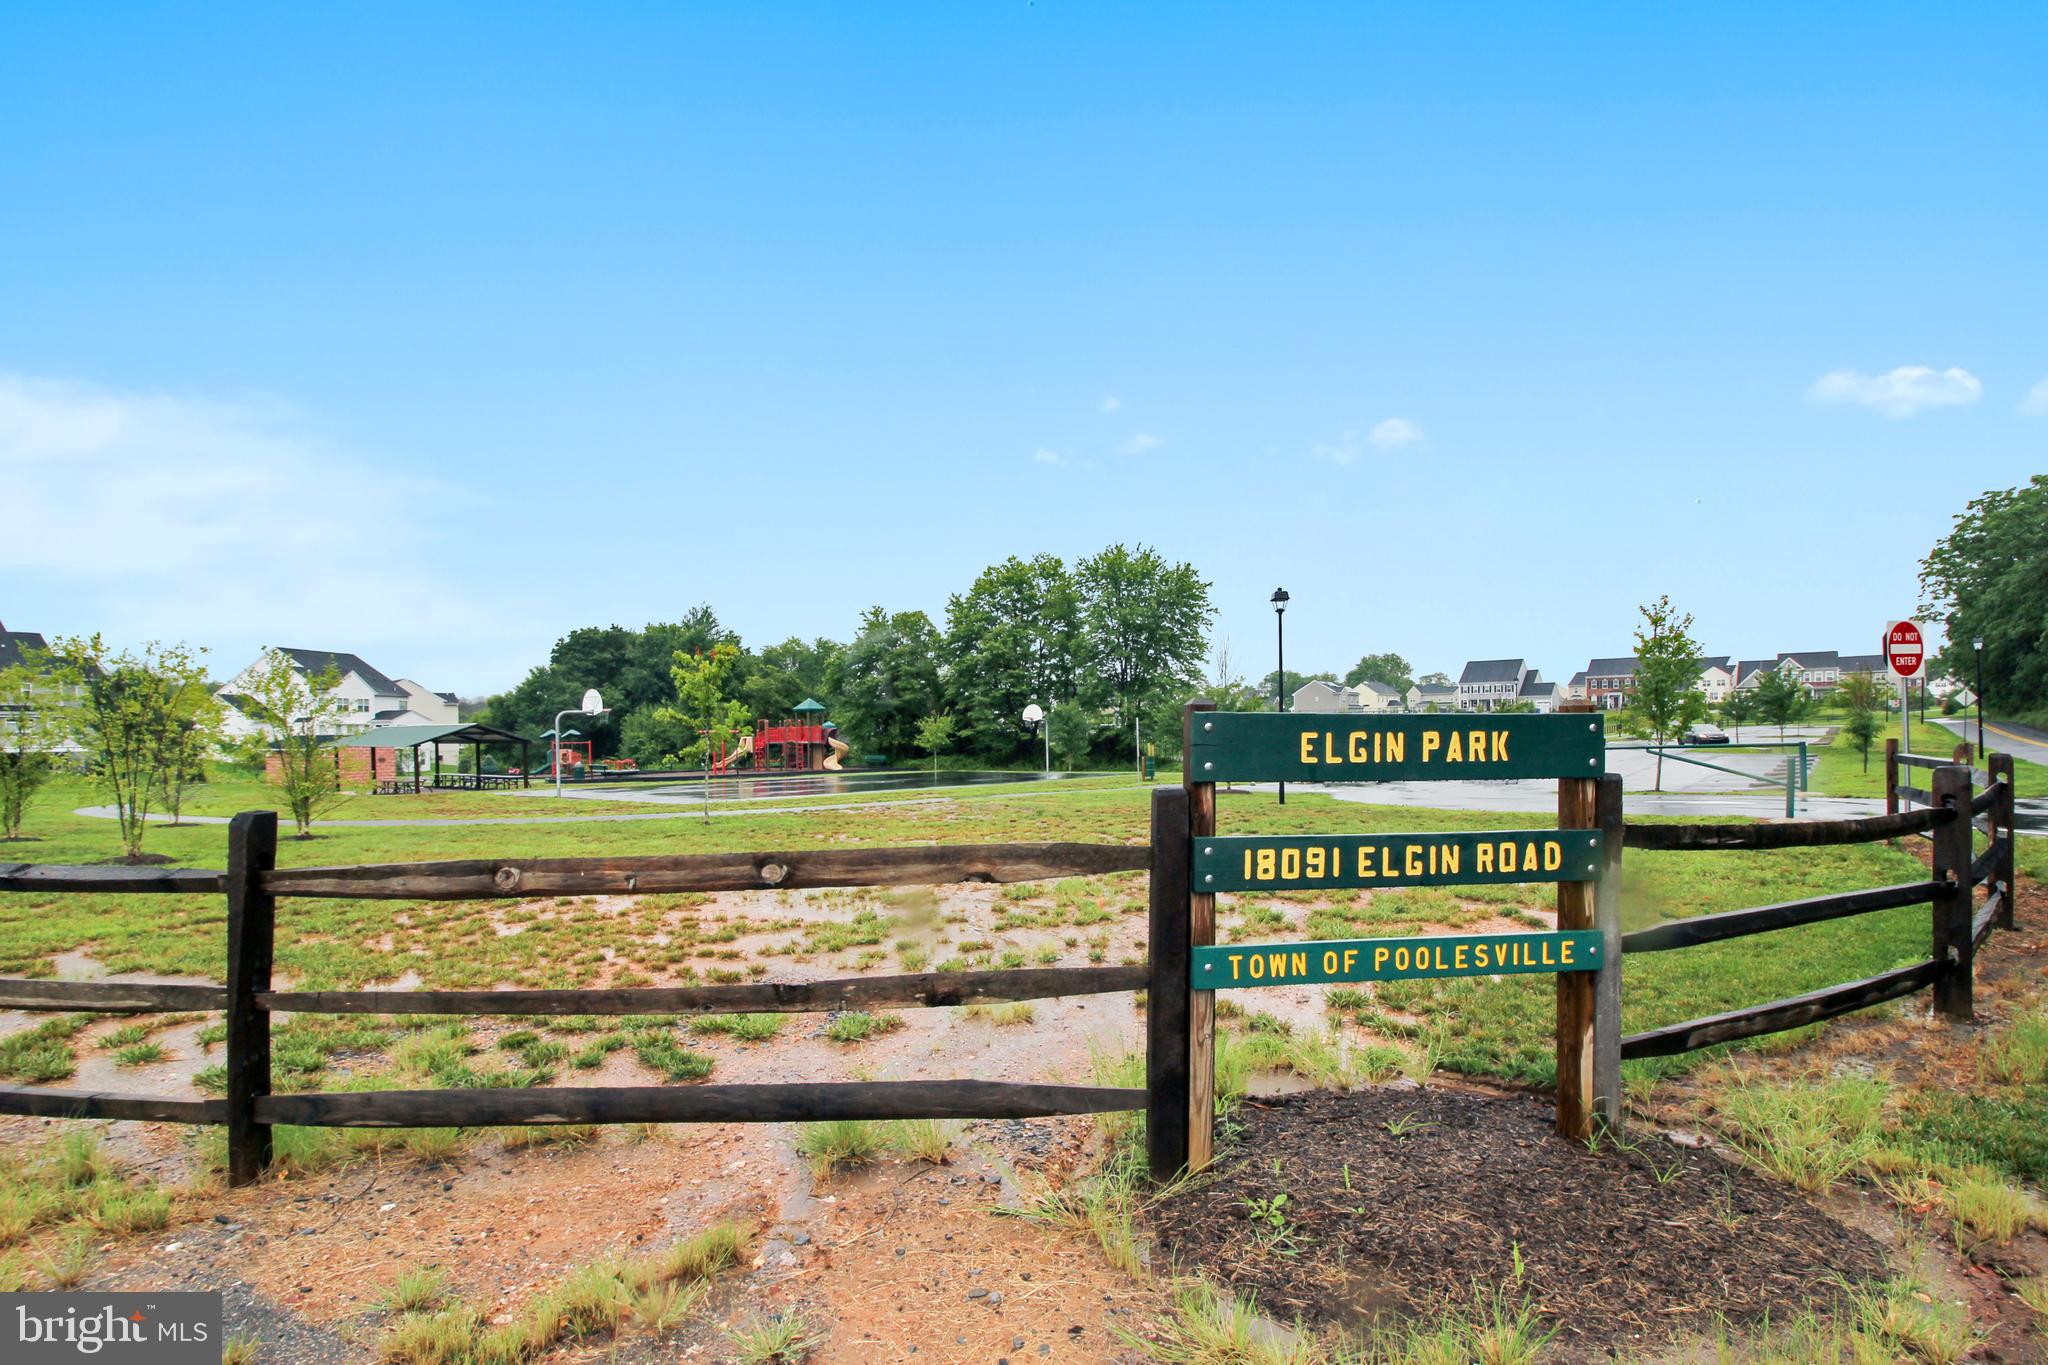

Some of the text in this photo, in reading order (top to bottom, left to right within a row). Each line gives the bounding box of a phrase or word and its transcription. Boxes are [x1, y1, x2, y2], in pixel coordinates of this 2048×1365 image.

[1892, 632, 1918, 641] DO NOT
[1896, 656, 1917, 666] ENTER
[1300, 730, 1509, 764] ELGIN PARK
[1244, 841, 1562, 881] 18091 ELGIN ROAD
[1228, 940, 1575, 980] TOWN OF POOLESVILLE
